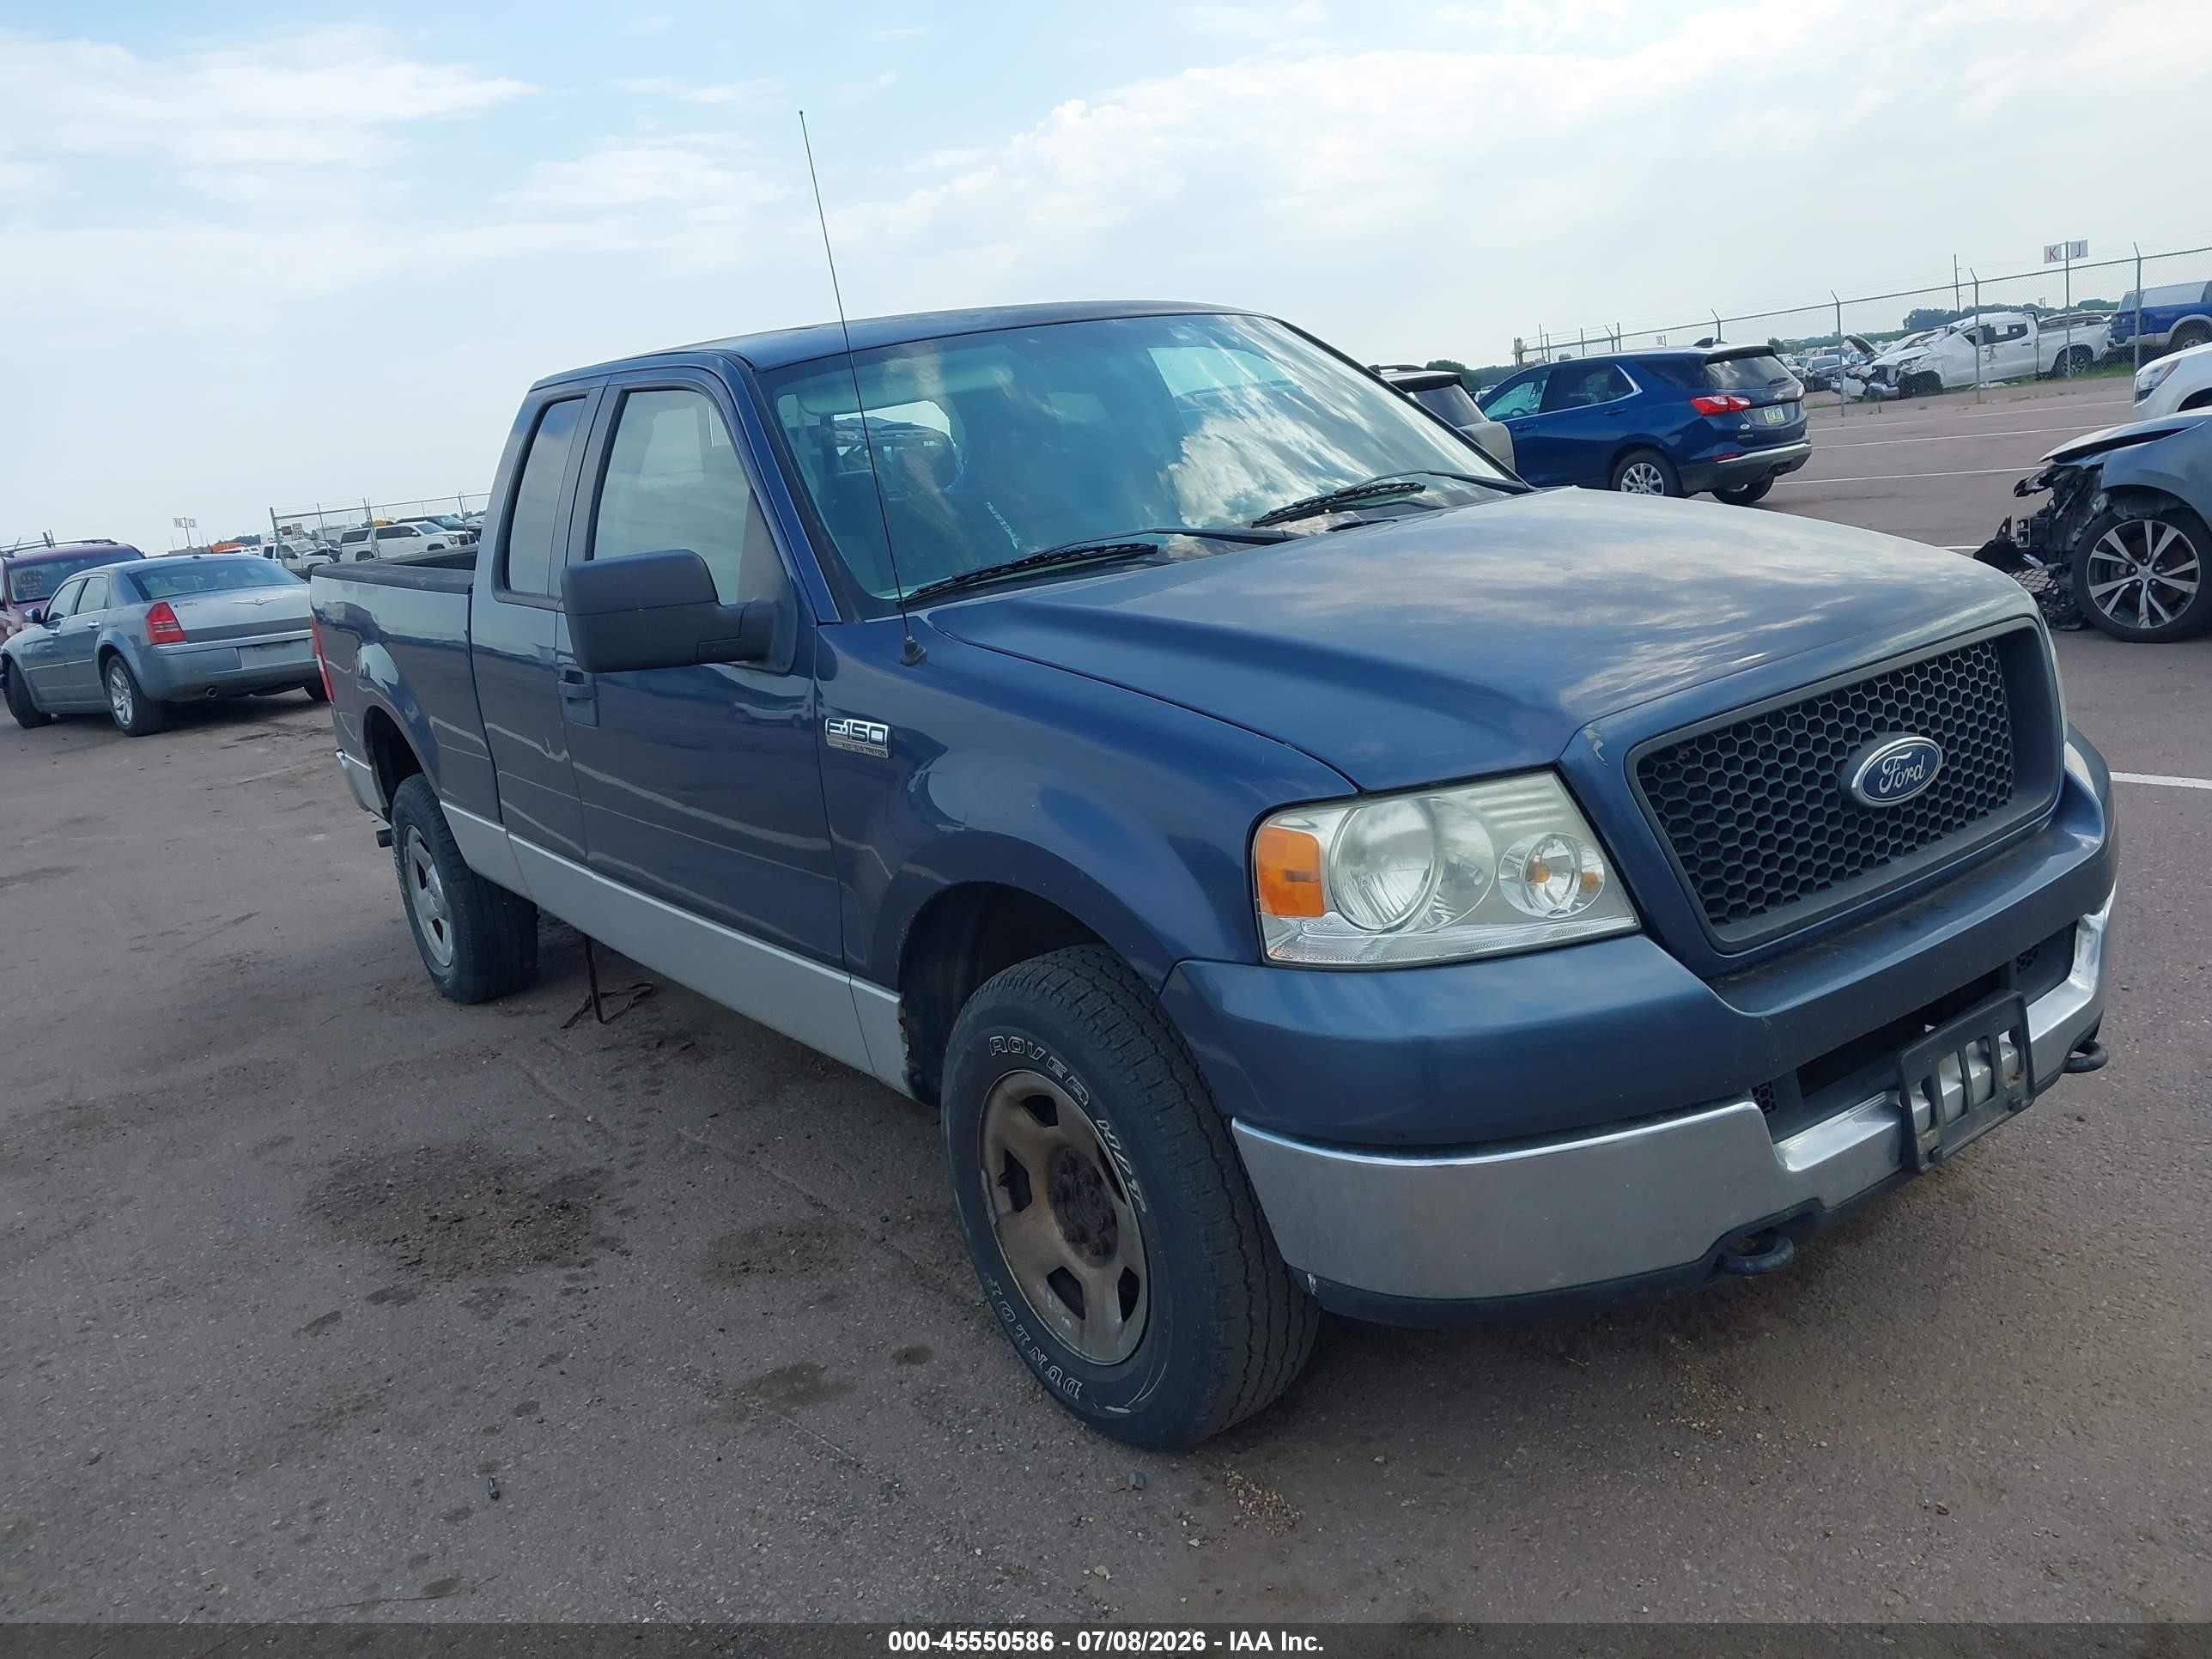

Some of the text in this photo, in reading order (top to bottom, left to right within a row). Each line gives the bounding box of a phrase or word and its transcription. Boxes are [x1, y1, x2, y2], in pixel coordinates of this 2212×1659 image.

[2049, 246, 2057, 262] K
[2075, 241, 2081, 258] J
[1879, 750, 1925, 793] Ford
[989, 1035, 1090, 1107] ROVER
